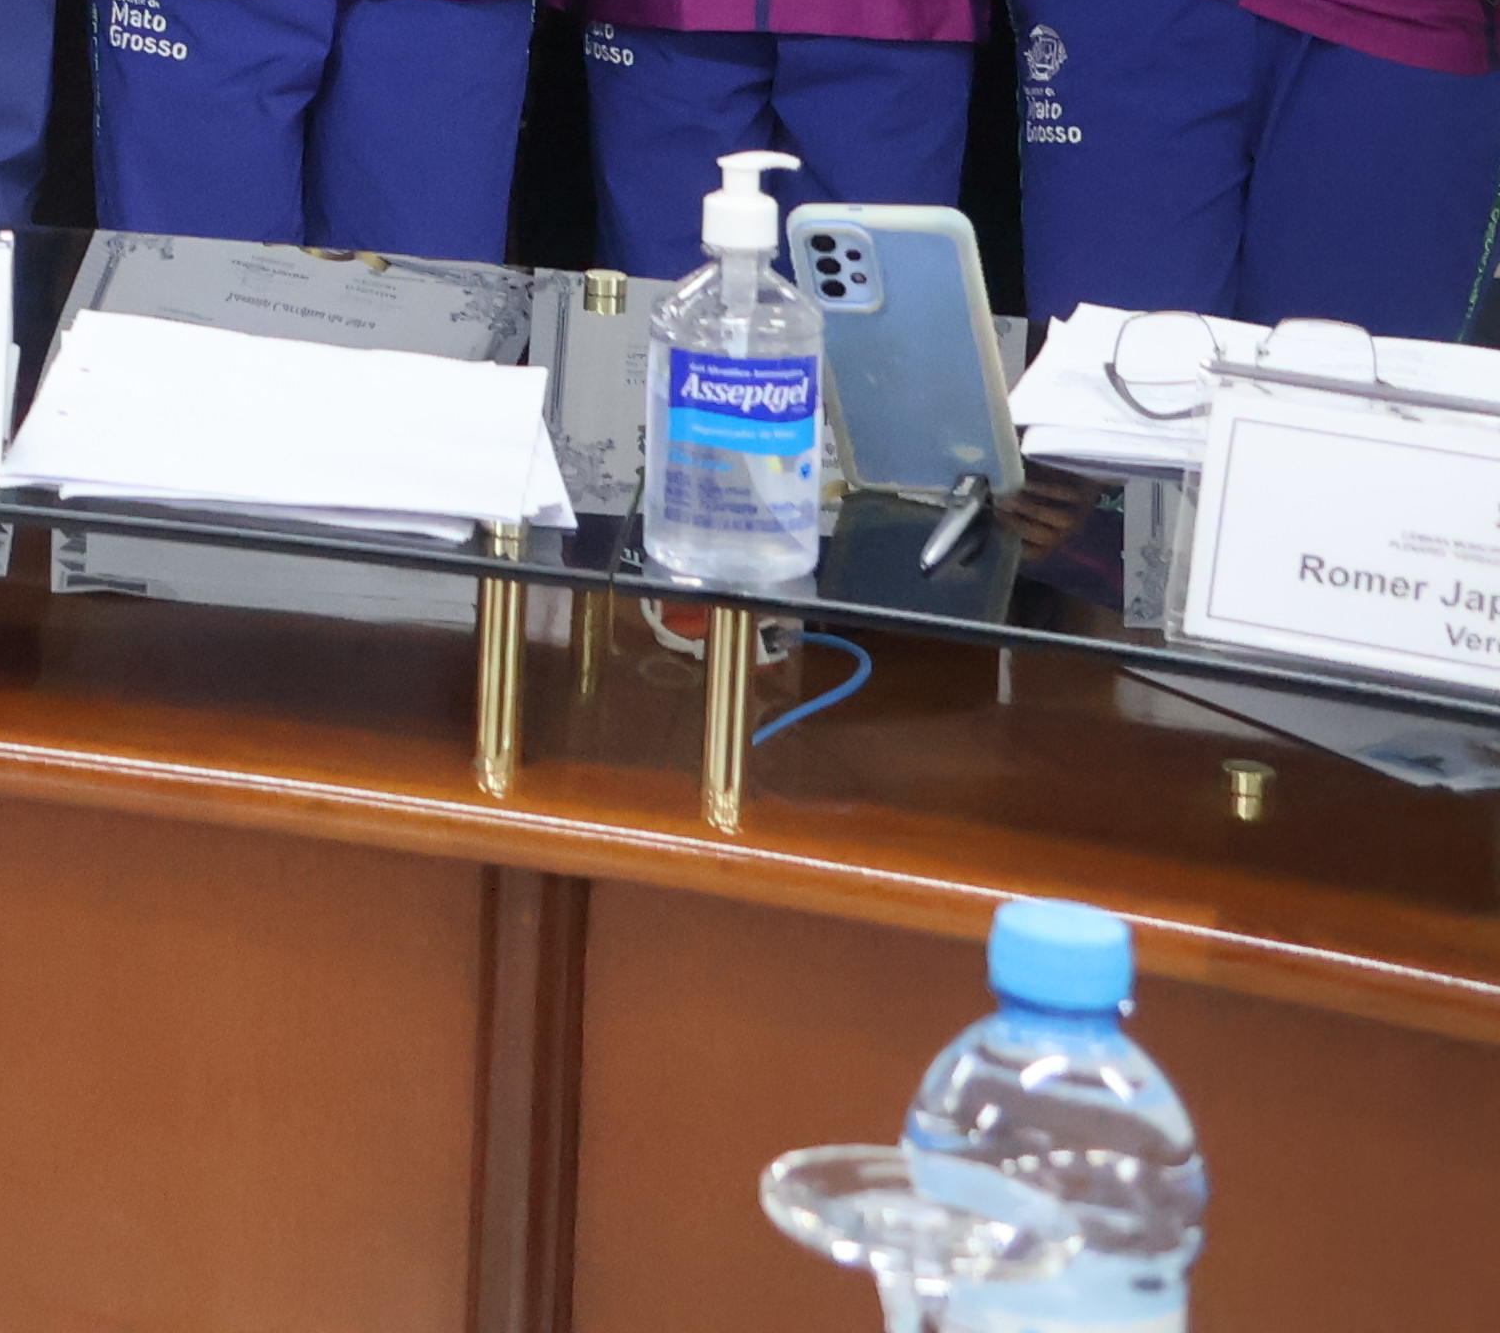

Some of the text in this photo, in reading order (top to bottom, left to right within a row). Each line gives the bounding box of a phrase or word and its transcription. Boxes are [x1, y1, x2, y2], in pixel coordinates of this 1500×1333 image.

[111, 0, 167, 33] Mato
[109, 24, 188, 61] Grosso
[681, 372, 811, 415] Asseptgel
[1299, 553, 1429, 602] Romer
